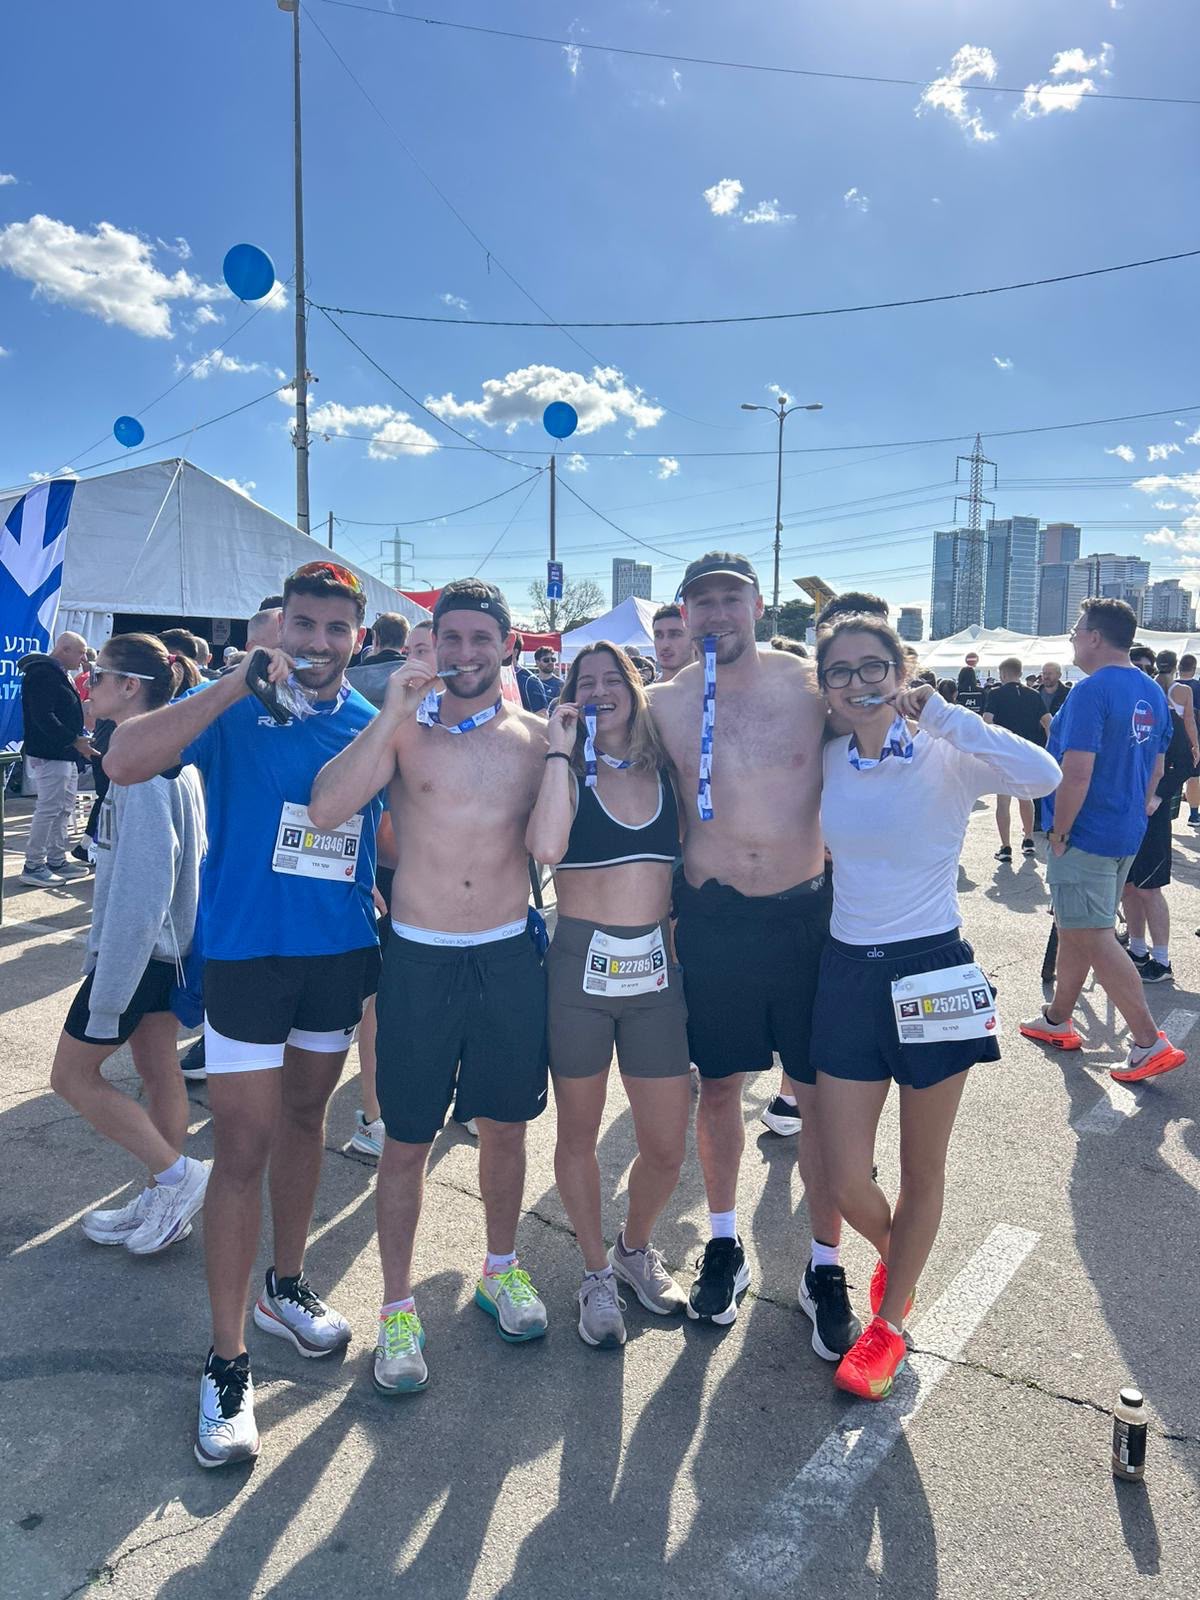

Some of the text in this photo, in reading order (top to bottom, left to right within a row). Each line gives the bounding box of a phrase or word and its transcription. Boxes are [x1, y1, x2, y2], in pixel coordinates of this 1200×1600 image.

[304, 832, 343, 853] B21346
[433, 936, 455, 945] Calvin
[867, 946, 884, 958] alo
[611, 958, 650, 974] B22785
[923, 993, 970, 1014] B25275
